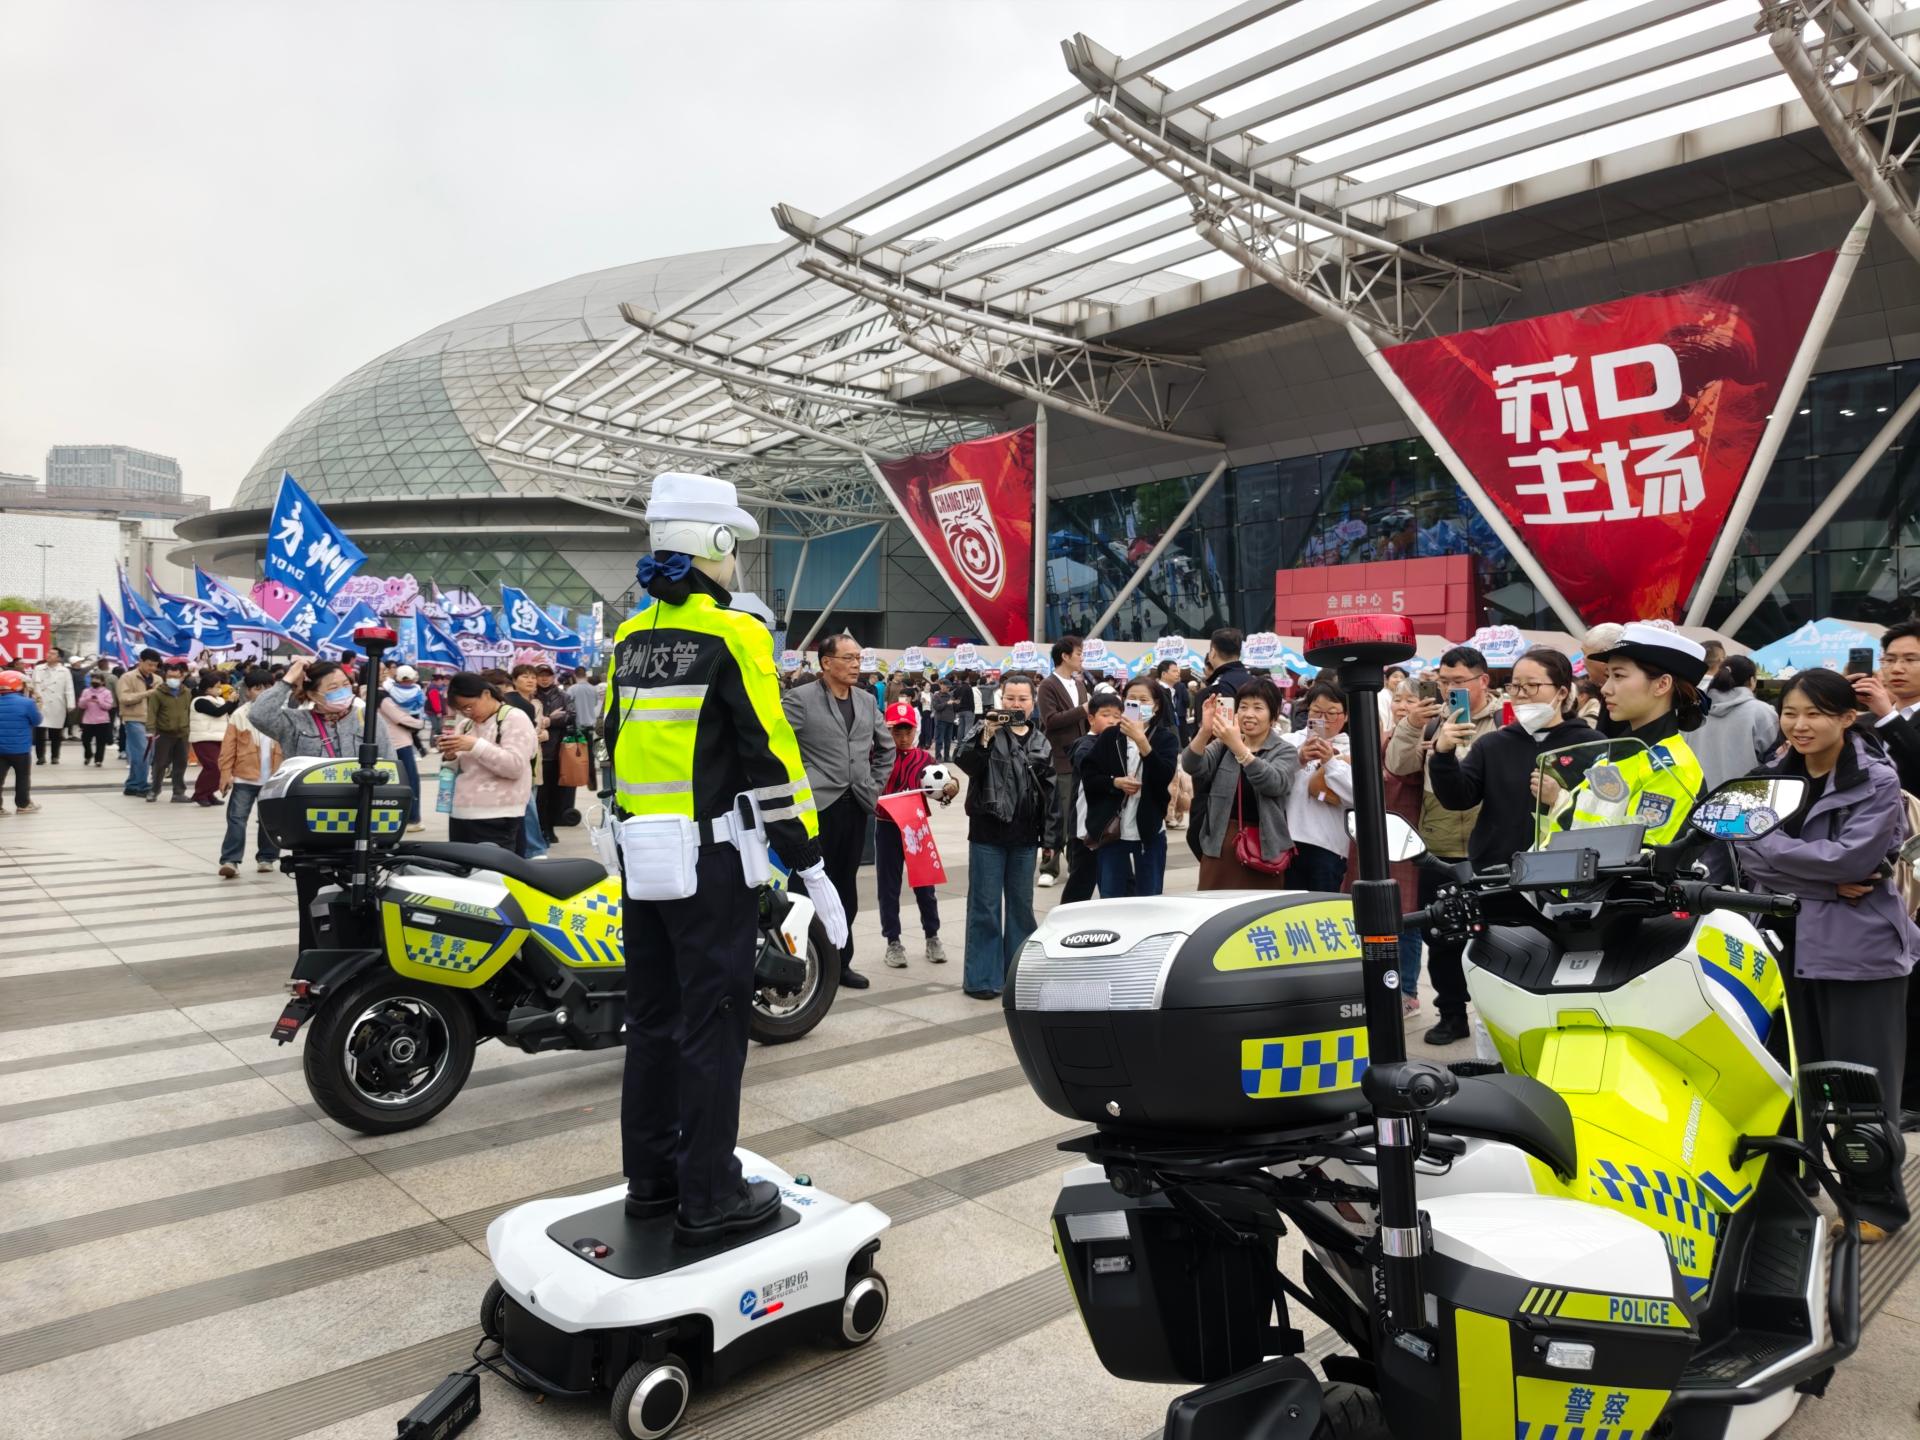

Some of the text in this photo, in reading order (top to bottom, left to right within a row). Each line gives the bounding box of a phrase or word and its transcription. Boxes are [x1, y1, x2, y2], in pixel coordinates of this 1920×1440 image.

[1507, 429, 1706, 524] 主场
[934, 486, 984, 514] CHANGZHOU
[270, 553, 306, 580] YONG
[1327, 590, 1405, 612] 会展中心 5
[453, 902, 489, 917] POLICE
[548, 905, 588, 933] 警察
[429, 933, 467, 954] 警察
[1065, 932, 1113, 946] HORWIN
[1722, 932, 1770, 983] 警察
[1681, 1095, 1703, 1166] HORWIN
[1660, 1231, 1697, 1269] LICE
[762, 1270, 809, 1297] 星宇股份
[1609, 1297, 1669, 1324] POLICE
[1564, 1387, 1630, 1425] 警察
